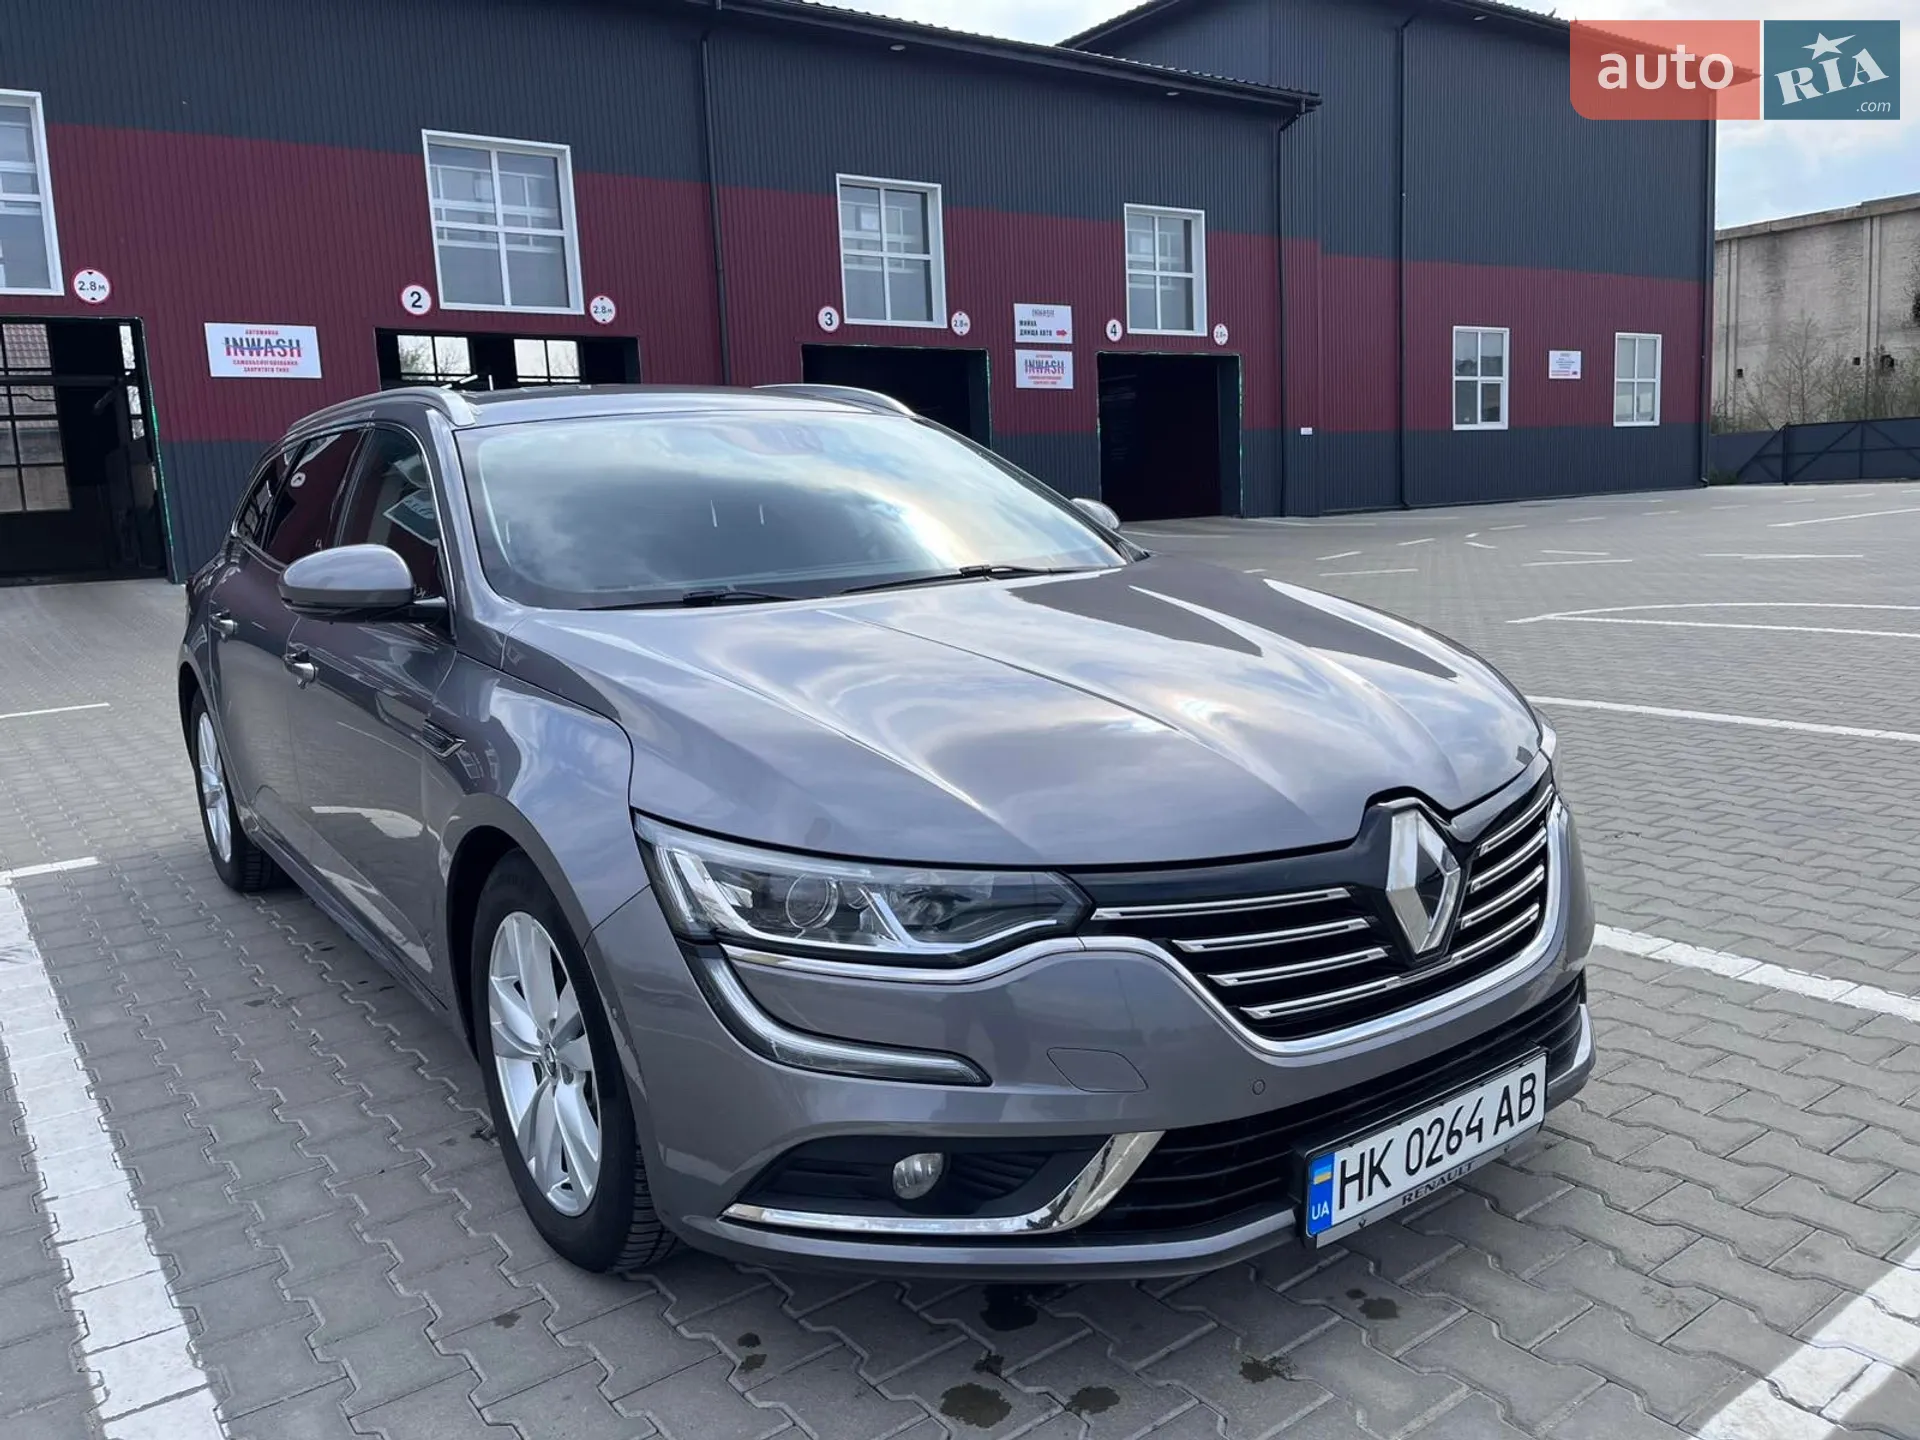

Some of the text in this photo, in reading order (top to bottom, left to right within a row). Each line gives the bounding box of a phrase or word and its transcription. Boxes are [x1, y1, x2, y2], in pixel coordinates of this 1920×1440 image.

[410, 291, 423, 308] 2
[824, 312, 833, 327] 3
[1110, 324, 1118, 336] 4
[224, 337, 302, 358] INWASH
[1024, 359, 1065, 374] INWASH
[1338, 1072, 1537, 1210] HK 0264 AB
[1401, 1161, 1476, 1206] RENAULT
[1311, 1201, 1330, 1220] UA
